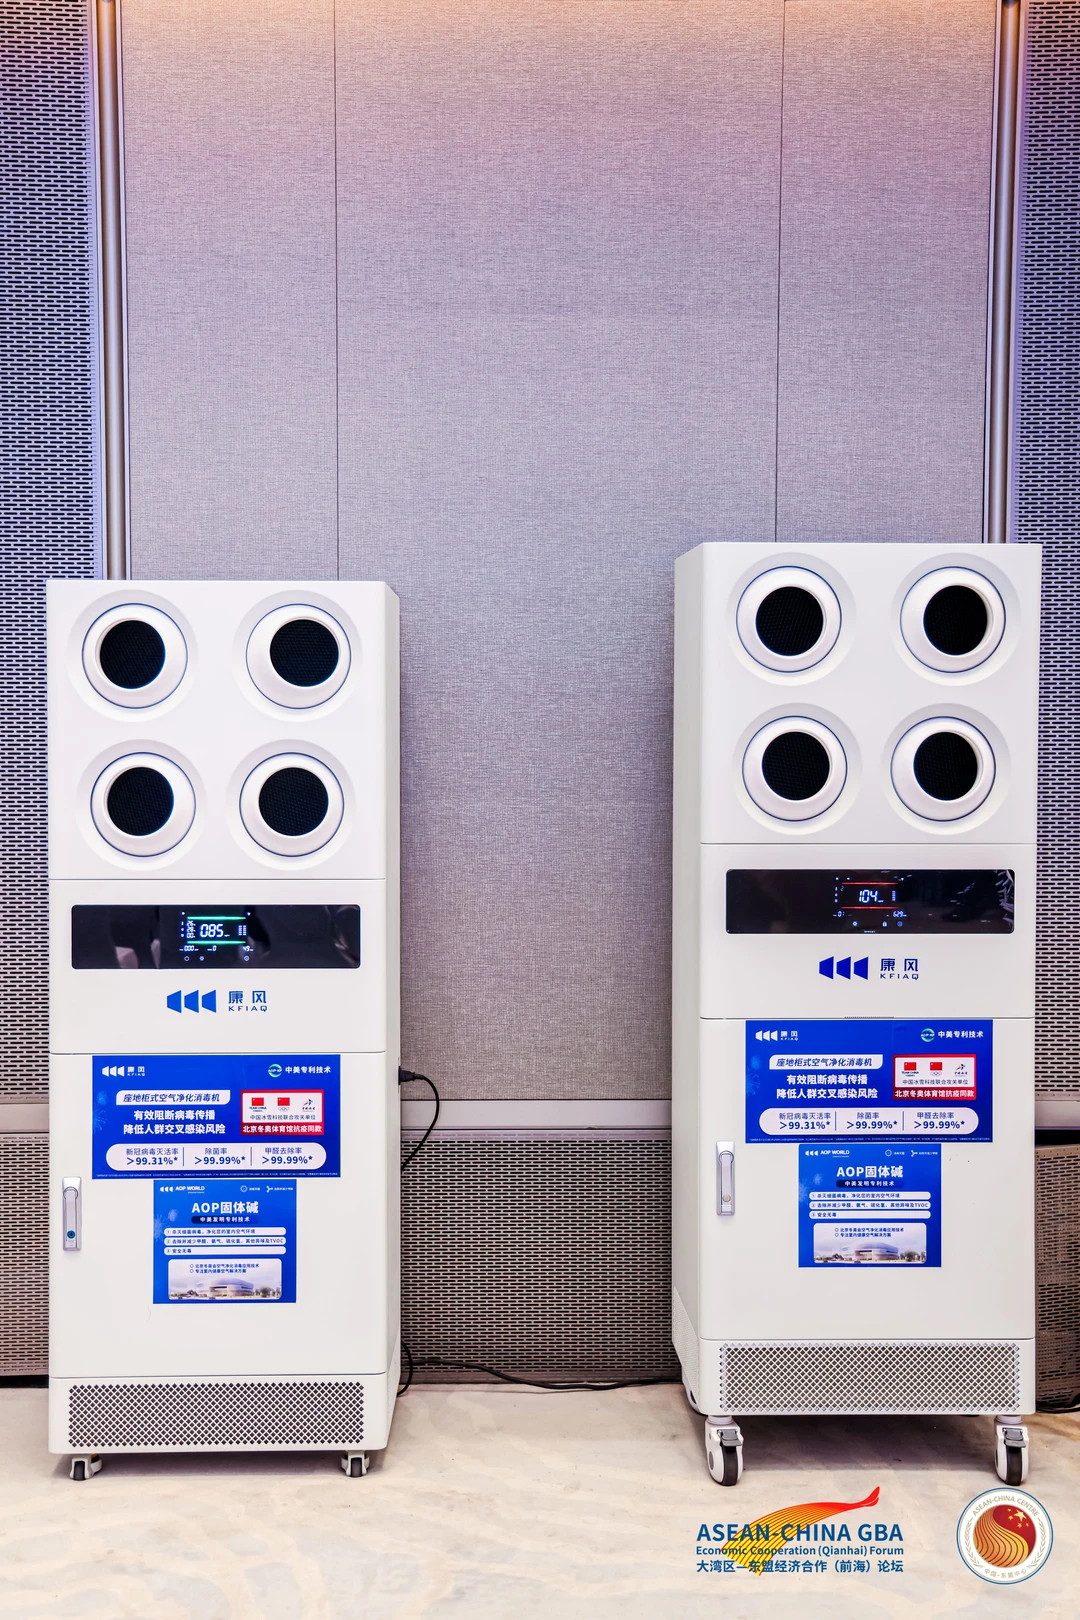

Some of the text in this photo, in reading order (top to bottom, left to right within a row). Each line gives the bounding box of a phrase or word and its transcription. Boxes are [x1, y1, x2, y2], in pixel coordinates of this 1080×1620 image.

[858, 889, 878, 903] 104
[200, 923, 224, 938] 085
[880, 958, 918, 971] 康风
[228, 990, 267, 1004] 康风
[938, 1030, 983, 1038] 中美专利技术
[776, 1058, 872, 1067] 座地柜式空气净化消毒机
[285, 1066, 331, 1074] 中美专利技术
[787, 1074, 868, 1085] 有效阻断病毒传播
[123, 1093, 220, 1102] 座地柜式空气净化消毒机
[776, 1088, 878, 1099] 降低人群交叉感染风险
[134, 1110, 215, 1120] 有效阻断病毒传播
[779, 1112, 831, 1120] 新冠病毒灭活率
[123, 1124, 226, 1134] 降低人群交叉感染风险
[243, 1125, 322, 1133] 北京冬奥体育馆抗疫同款
[205, 1147, 227, 1155] 除菌率
[836, 1166, 903, 1178] AOP固体碱
[191, 1201, 259, 1213] AOP固体碱
